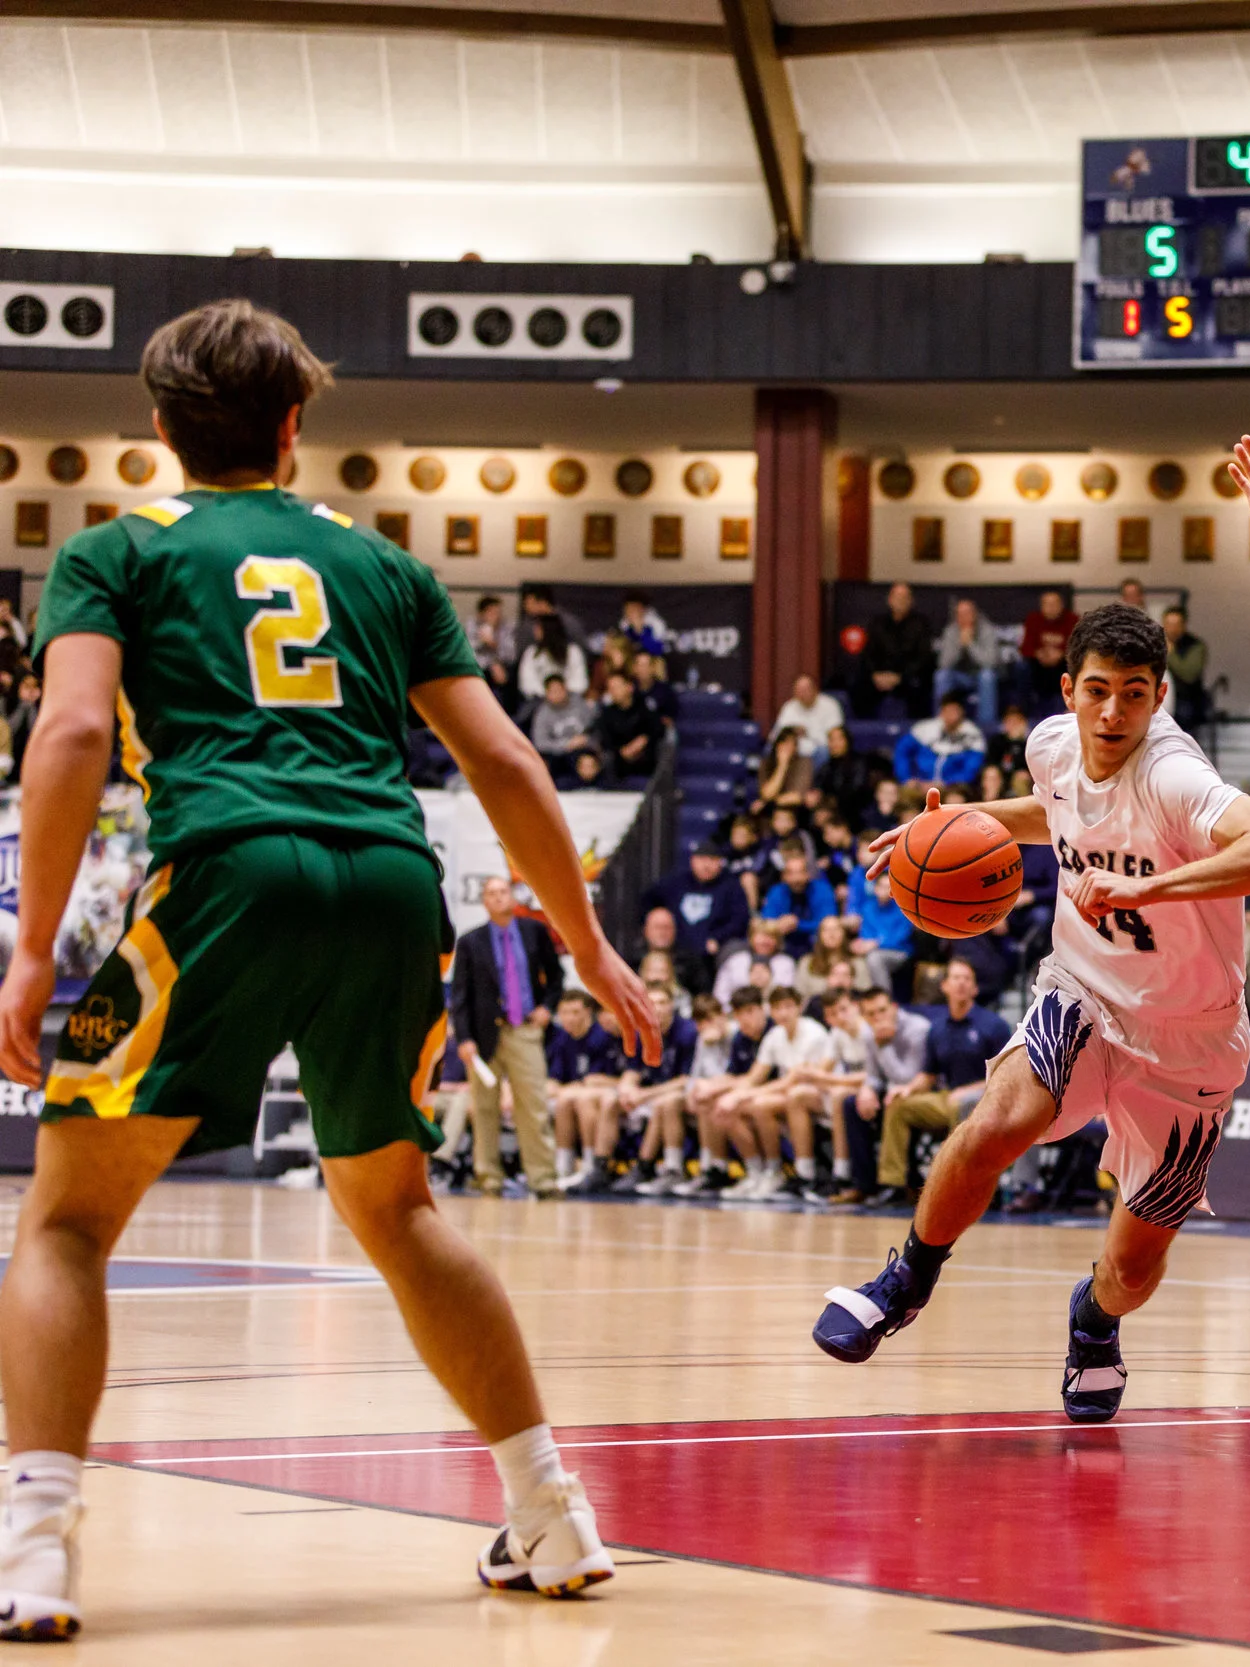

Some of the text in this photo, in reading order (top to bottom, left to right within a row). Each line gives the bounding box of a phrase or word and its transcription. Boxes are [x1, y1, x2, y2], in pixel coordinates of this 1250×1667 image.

[1145, 225, 1178, 278] 5
[1123, 299, 1140, 336] 1
[1164, 295, 1193, 338] 5
[235, 555, 343, 708] 2
